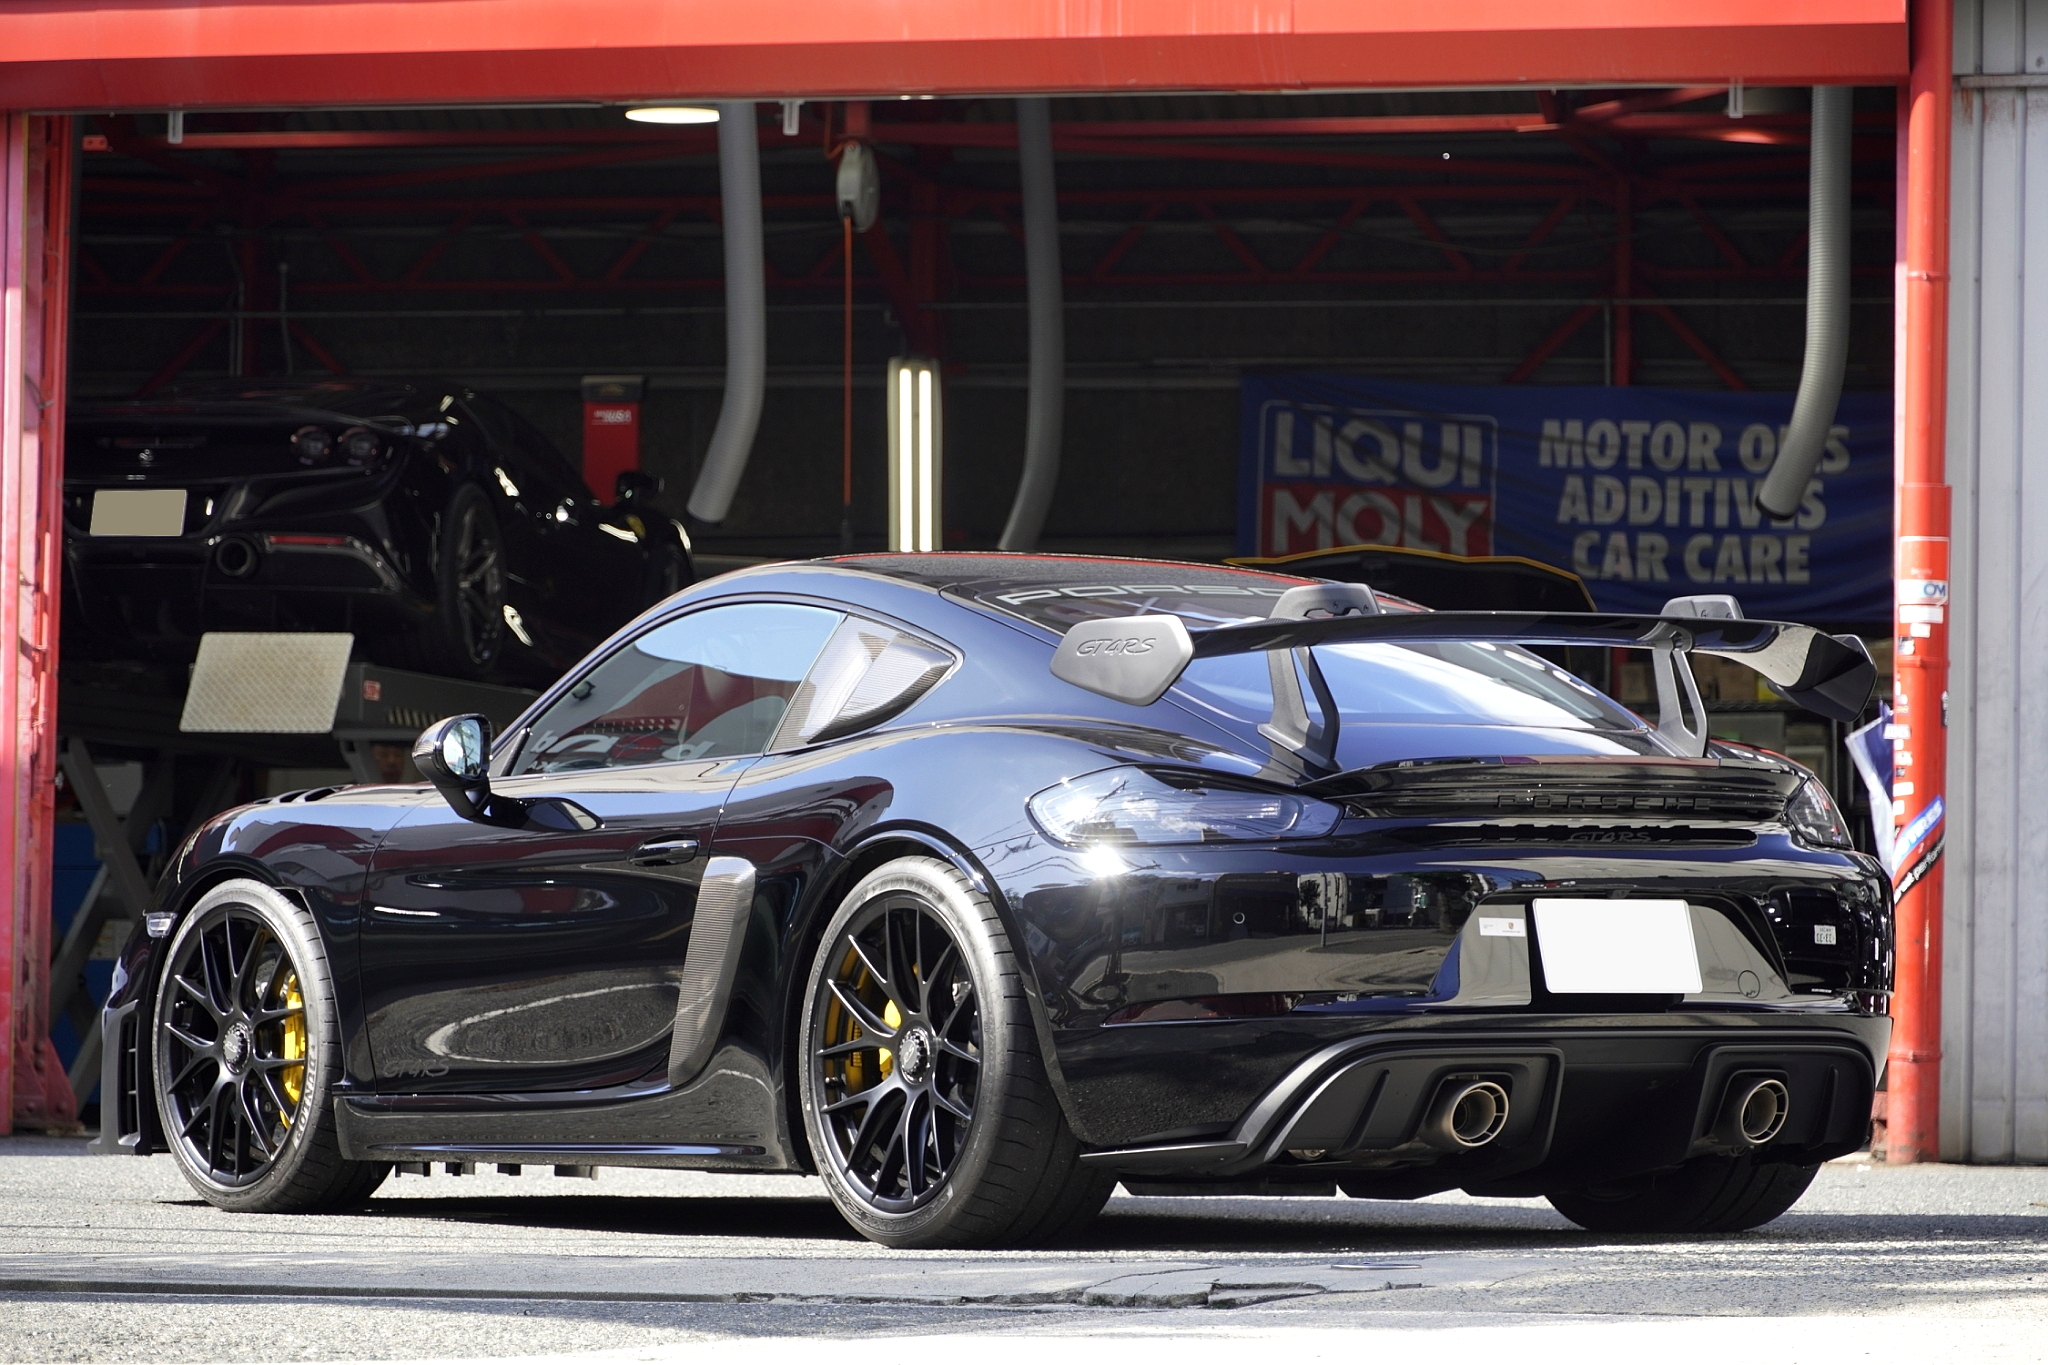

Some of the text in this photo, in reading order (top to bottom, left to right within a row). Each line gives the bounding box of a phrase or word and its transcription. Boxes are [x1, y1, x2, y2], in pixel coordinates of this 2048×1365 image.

[1274, 411, 1483, 488] LIQUI
[1539, 419, 1849, 474] MOTOR OS
[1272, 489, 1489, 556] MOLY
[1557, 475, 1827, 530] ADDITIVS
[1572, 531, 1811, 584] CAR CARE
[996, 584, 1287, 606] PORSC
[1497, 794, 1711, 810] PORSCHE
[296, 1057, 317, 1140] DUNLOP
